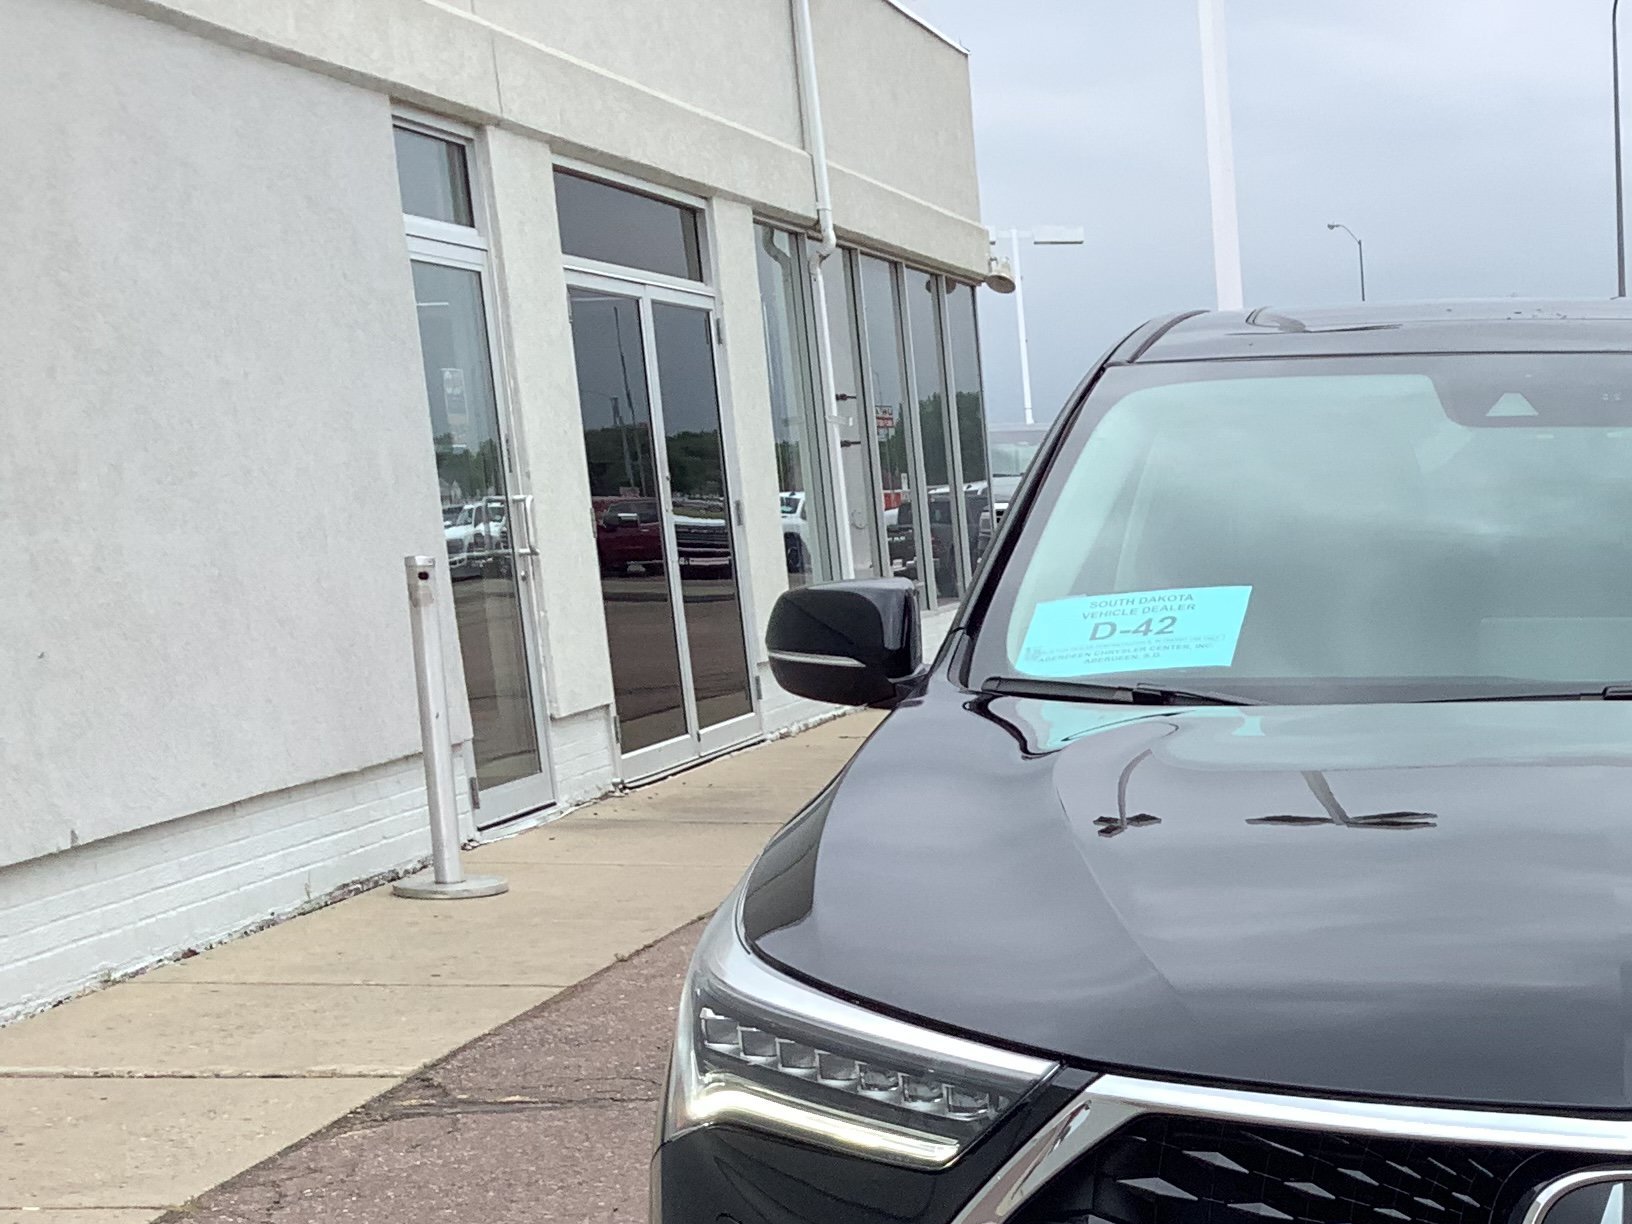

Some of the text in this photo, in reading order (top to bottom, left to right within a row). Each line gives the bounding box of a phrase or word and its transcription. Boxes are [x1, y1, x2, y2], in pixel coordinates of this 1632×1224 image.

[1089, 593, 1194, 609] SOUTH DAKOTA
[1082, 603, 1196, 620] VEHICLE DEALER
[1089, 615, 1178, 641] D-42
